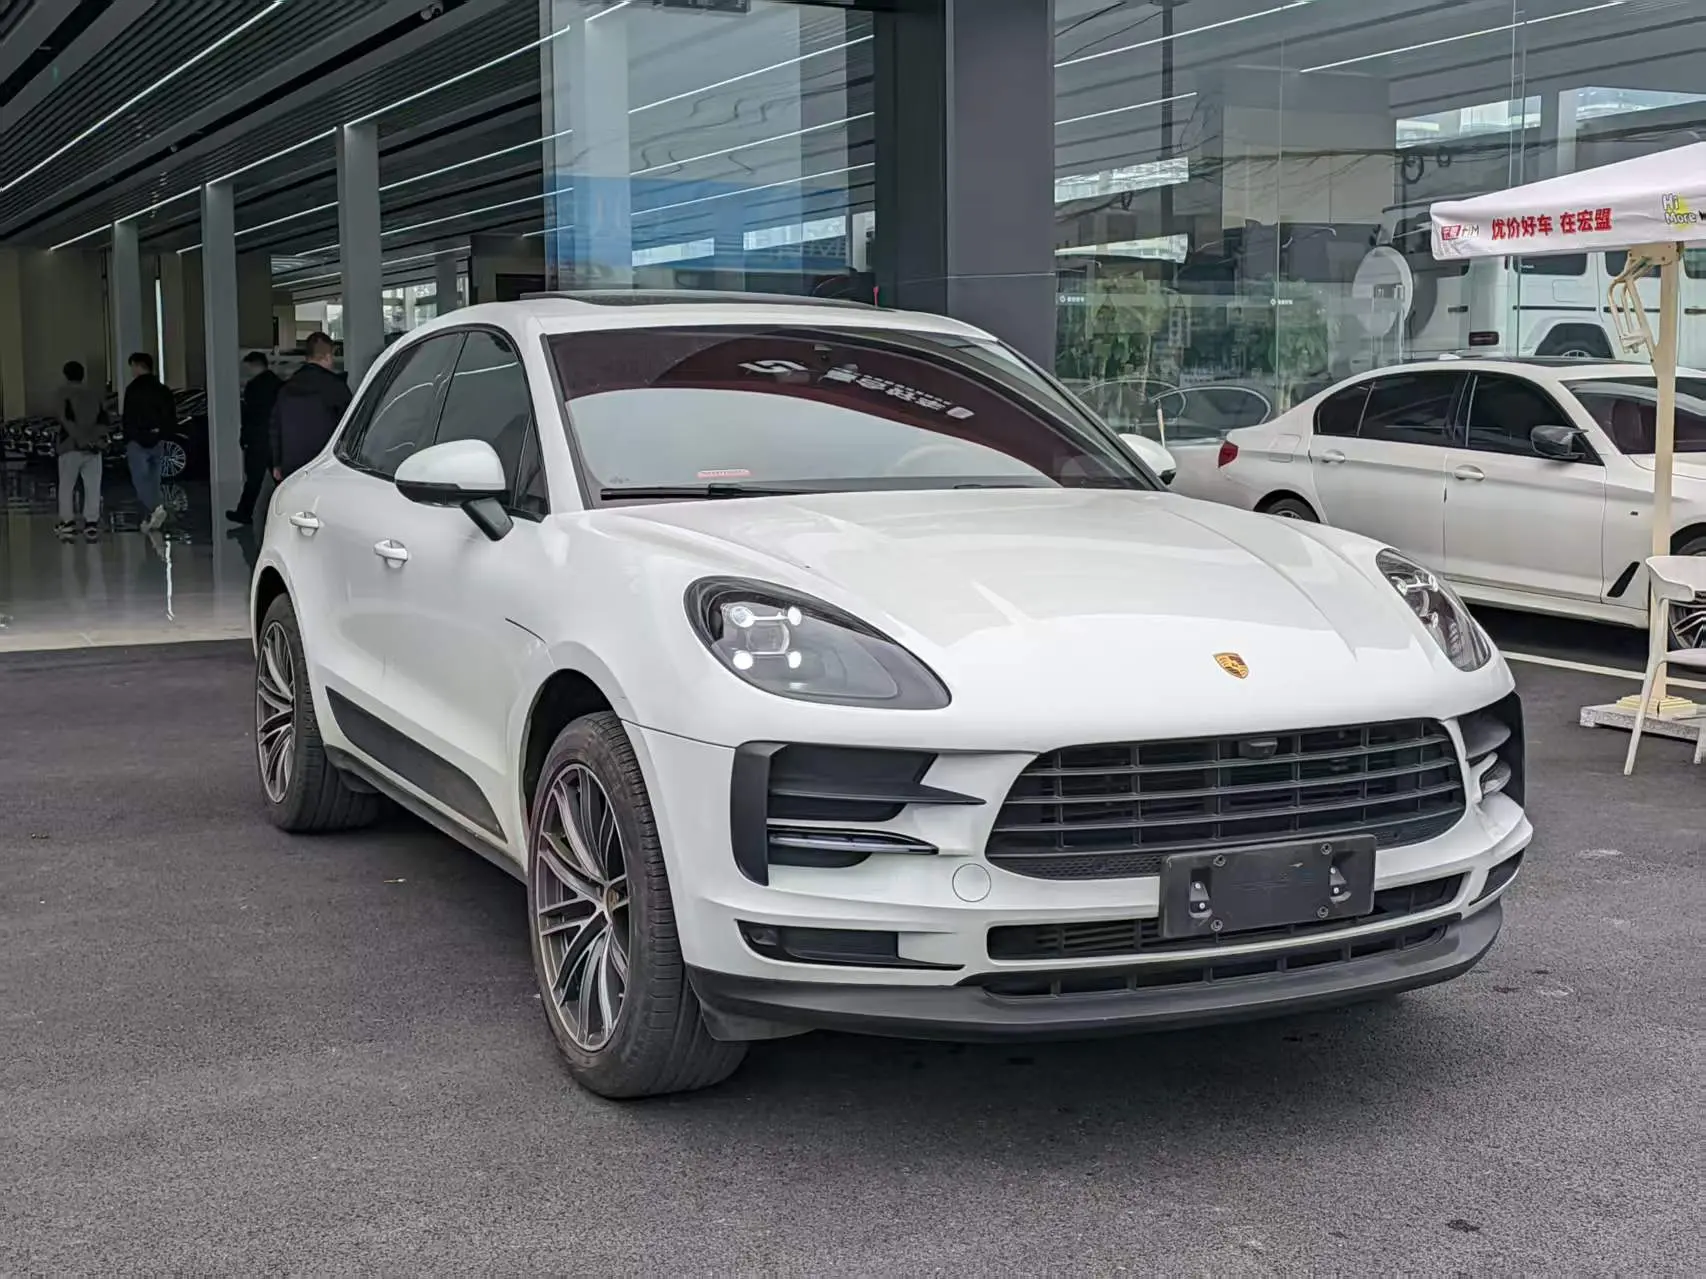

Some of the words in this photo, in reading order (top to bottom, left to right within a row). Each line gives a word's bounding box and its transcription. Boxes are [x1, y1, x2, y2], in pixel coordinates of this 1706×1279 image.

[1661, 192, 1680, 210] Hi
[1491, 213, 1553, 240] 优价好车
[1559, 207, 1612, 234] 在宏盟
[1664, 210, 1698, 225] More
